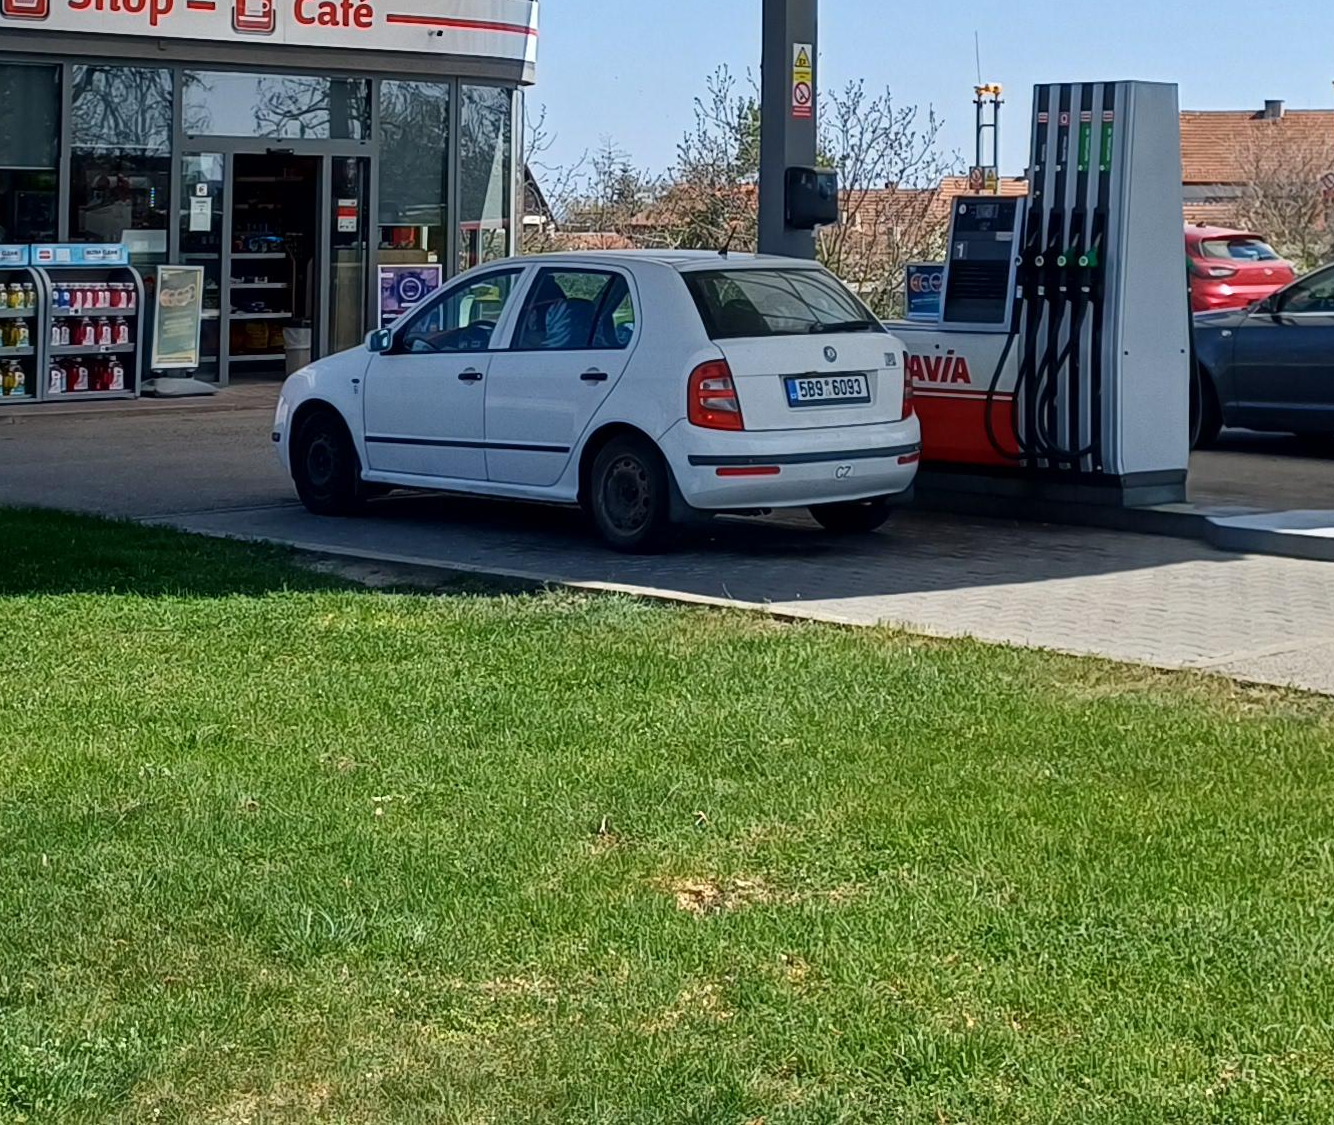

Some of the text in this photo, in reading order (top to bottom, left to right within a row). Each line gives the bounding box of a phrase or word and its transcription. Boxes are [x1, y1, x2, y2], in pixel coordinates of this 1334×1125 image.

[956, 243, 964, 259] 1
[798, 378, 862, 398] 5B9 6093
[834, 465, 852, 479] CZ
